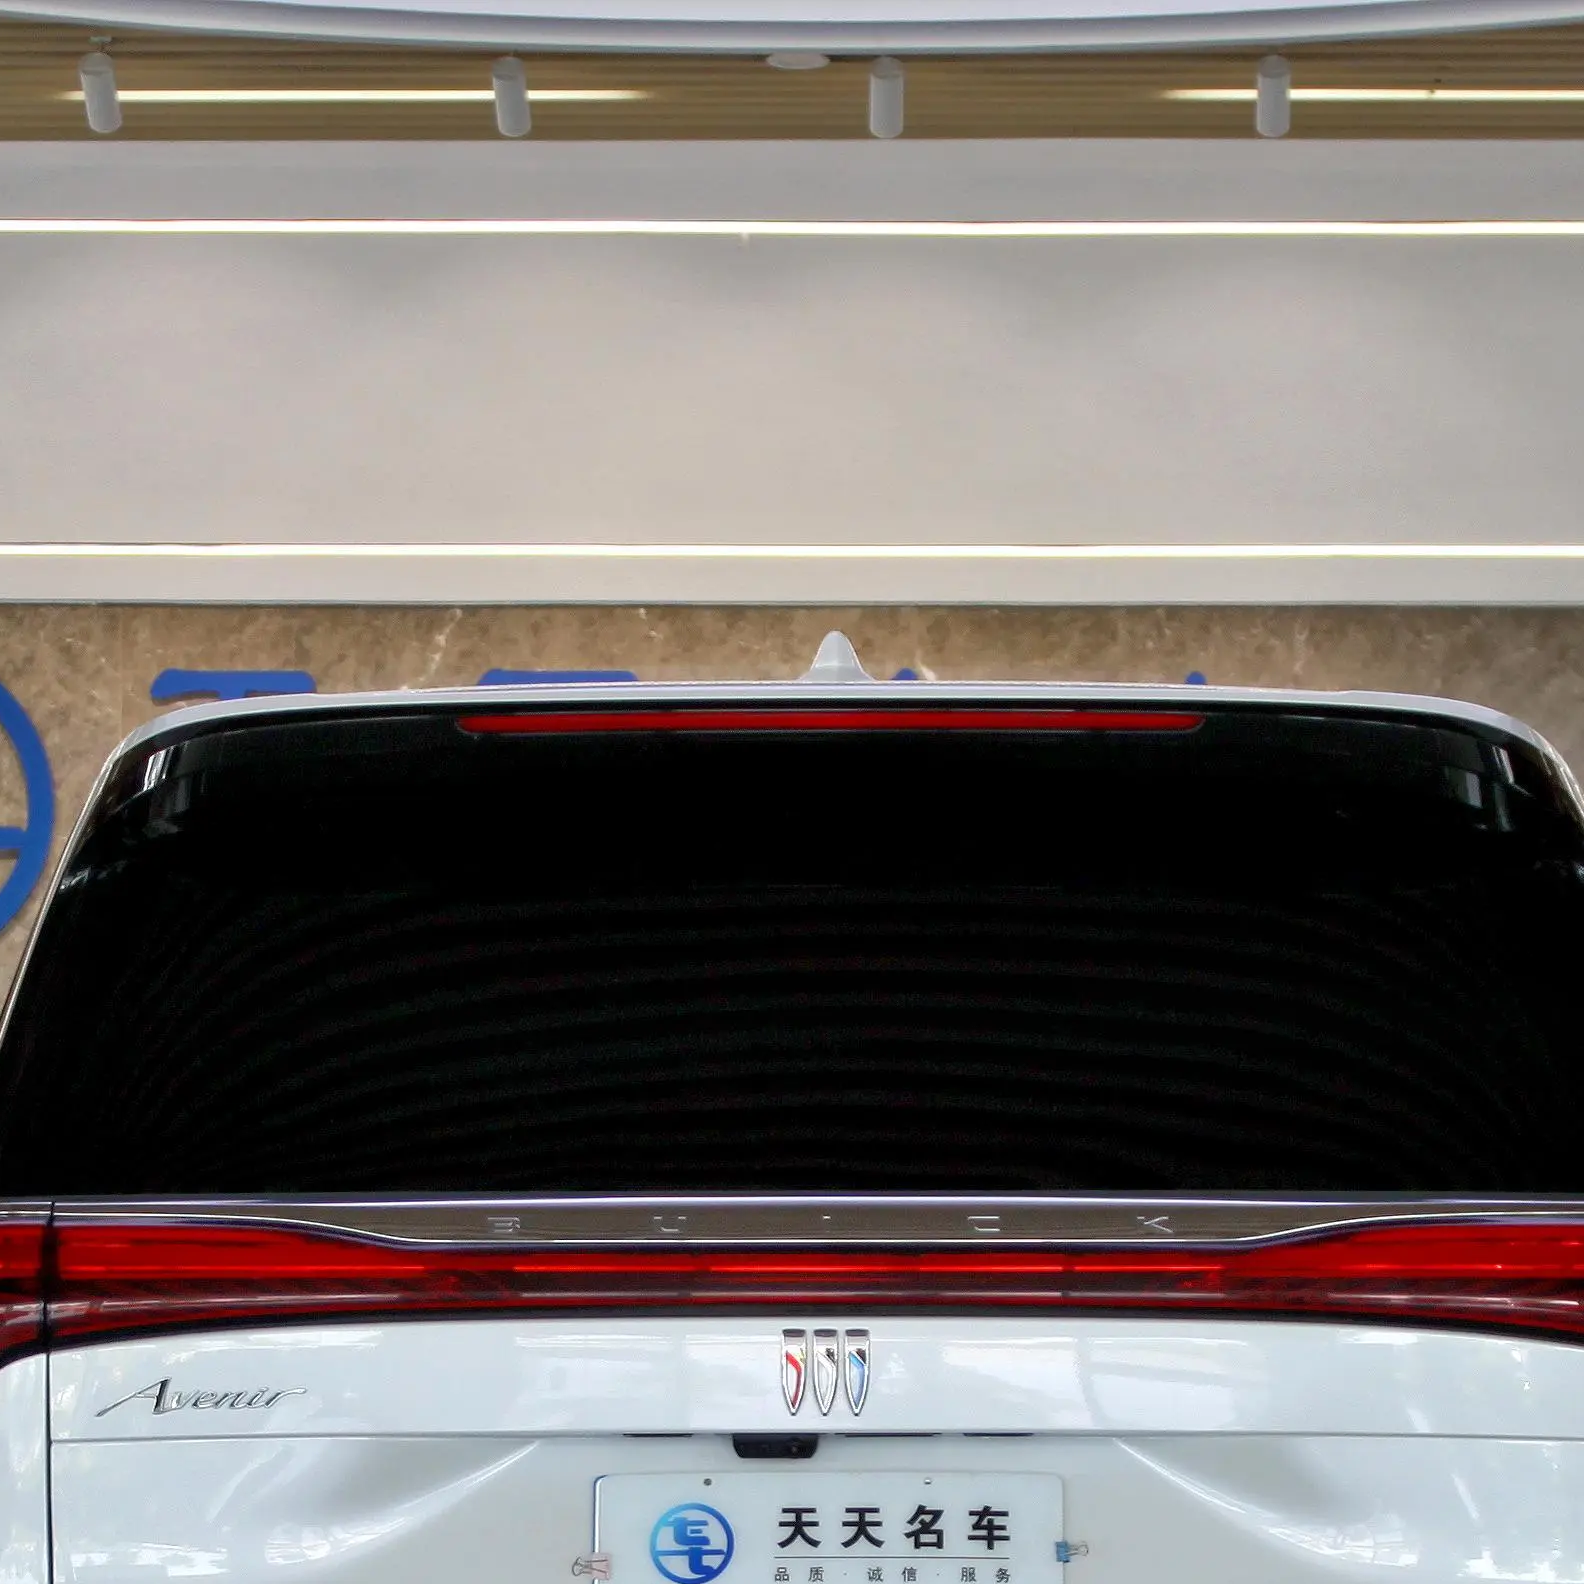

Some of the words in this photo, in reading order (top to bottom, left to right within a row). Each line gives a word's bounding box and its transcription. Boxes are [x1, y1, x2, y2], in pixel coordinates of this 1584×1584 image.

[94, 1376, 307, 1417] Avenir
[776, 1504, 1011, 1550] 天天名车
